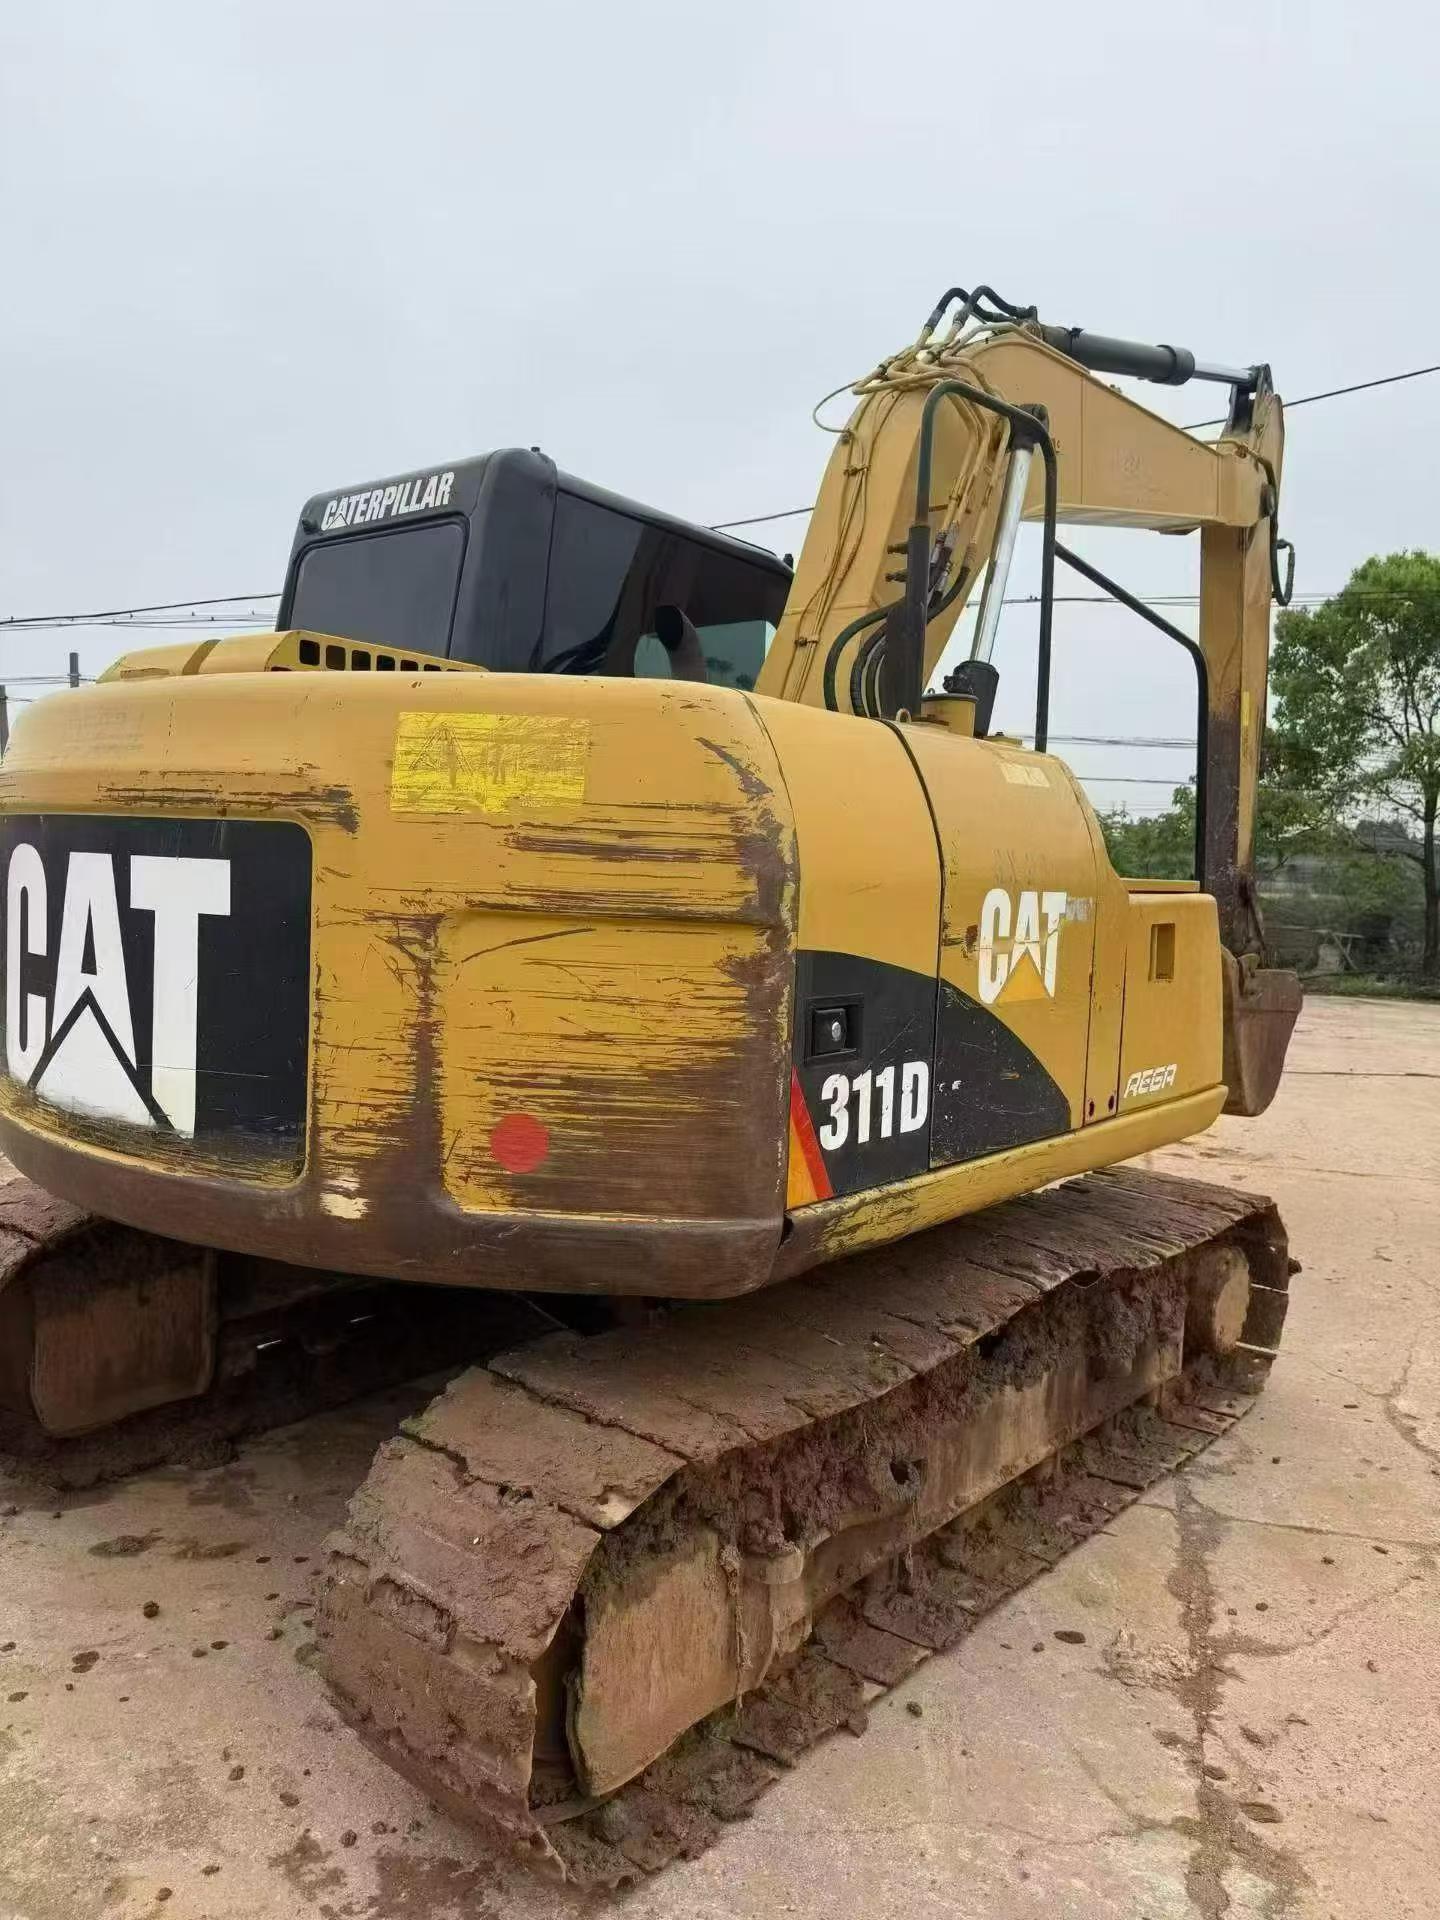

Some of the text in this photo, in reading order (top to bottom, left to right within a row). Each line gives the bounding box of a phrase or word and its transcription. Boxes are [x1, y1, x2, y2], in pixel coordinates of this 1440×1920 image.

[320, 471, 455, 531] CATERPILLAR
[6, 842, 231, 1139] CAT
[978, 888, 1067, 1004] CAT
[819, 1060, 929, 1151] 311D
